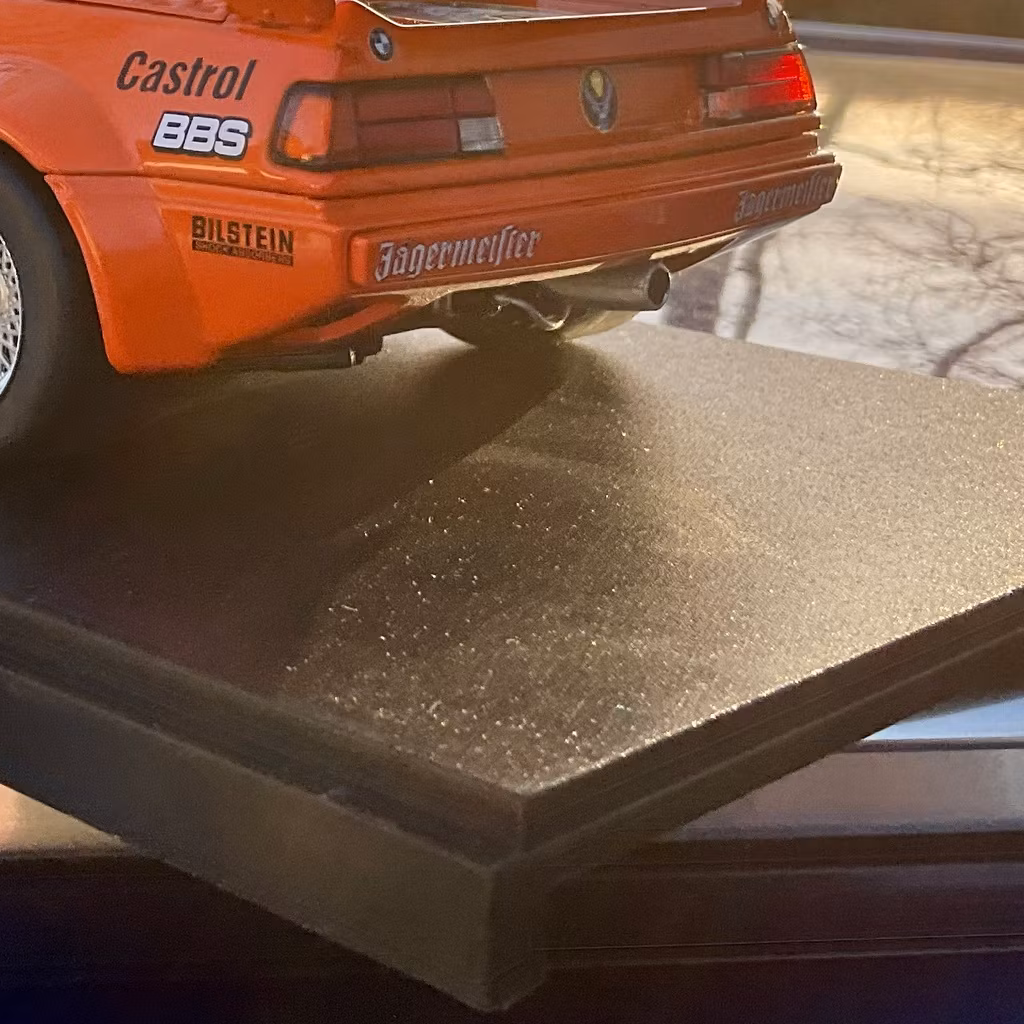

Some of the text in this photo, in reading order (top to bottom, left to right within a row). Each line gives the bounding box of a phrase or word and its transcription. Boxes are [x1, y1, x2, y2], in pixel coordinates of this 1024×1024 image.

[116, 50, 257, 101] Castrol
[151, 110, 253, 161] BBS
[191, 215, 294, 254] BILSTEIN
